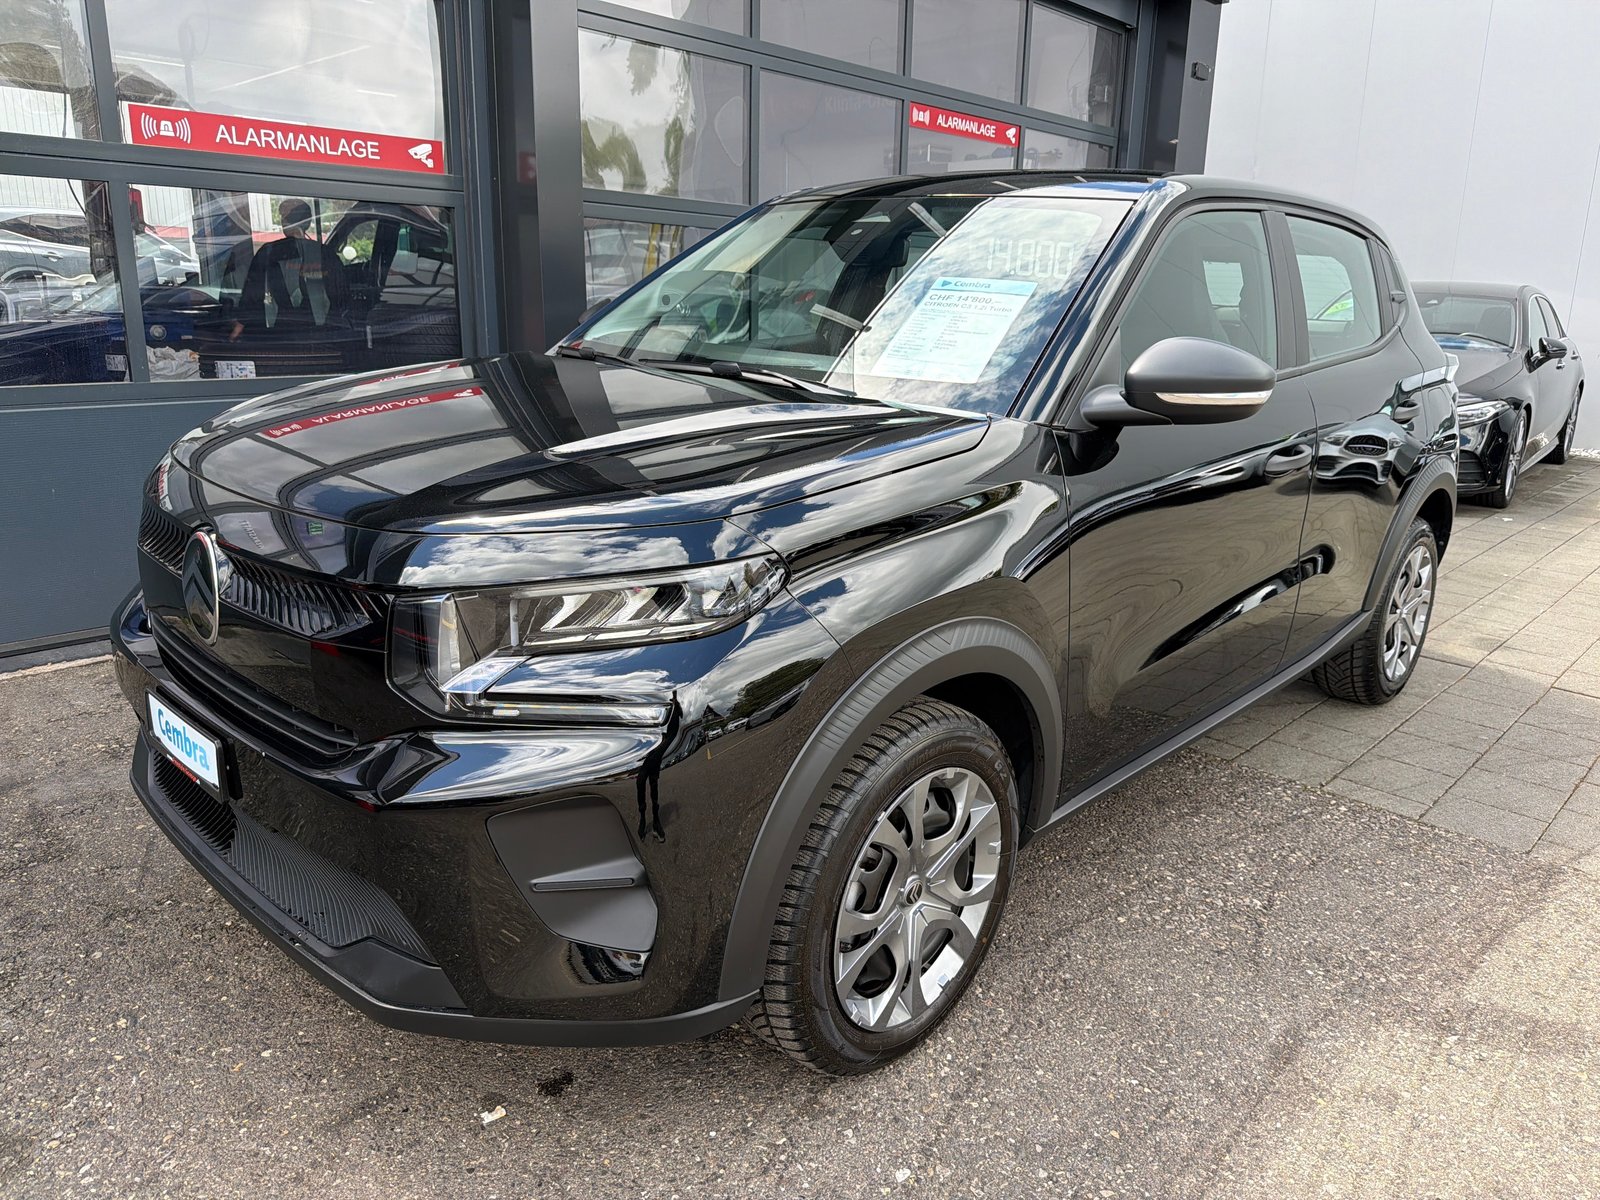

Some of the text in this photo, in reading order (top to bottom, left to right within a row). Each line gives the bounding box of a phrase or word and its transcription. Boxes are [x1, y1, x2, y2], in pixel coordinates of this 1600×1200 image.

[936, 113, 996, 138] ALARMANLAGE
[215, 124, 381, 160] ALARMANLAGE
[929, 293, 954, 301] CHF
[953, 280, 991, 289] Cembra
[157, 708, 210, 771] Cembra
